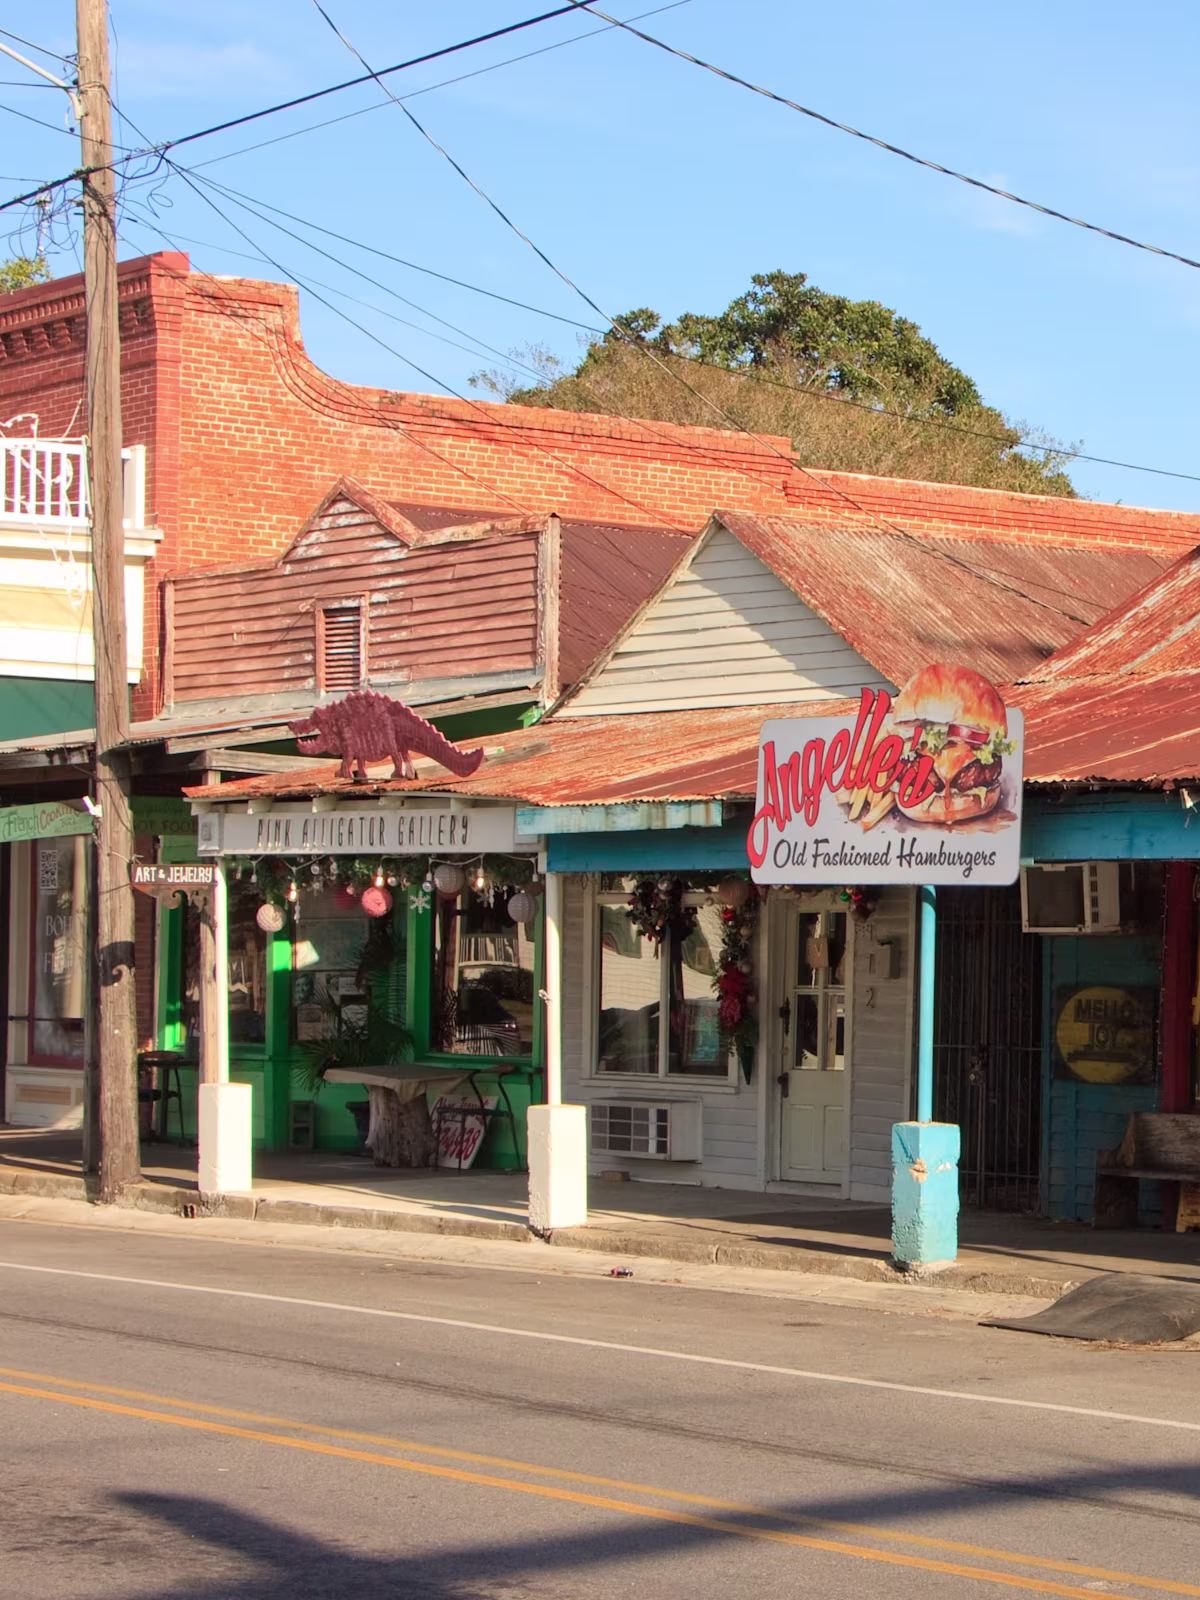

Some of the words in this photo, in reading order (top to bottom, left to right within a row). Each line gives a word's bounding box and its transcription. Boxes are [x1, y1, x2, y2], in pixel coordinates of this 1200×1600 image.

[746, 687, 935, 868] Angelle's
[1, 806, 42, 838] French
[257, 818, 292, 847] PINK
[303, 817, 387, 846] ALLIGATOR
[398, 815, 469, 846] GALLERY
[773, 838, 808, 868] Old
[812, 838, 891, 868] Fashioned
[896, 837, 996, 878] Hamburgers
[135, 866, 157, 882] ART
[158, 868, 165, 879] &
[167, 866, 213, 883] JEWELRY
[1074, 999, 1138, 1022] MELLO
[1087, 1023, 1117, 1050] JOY
